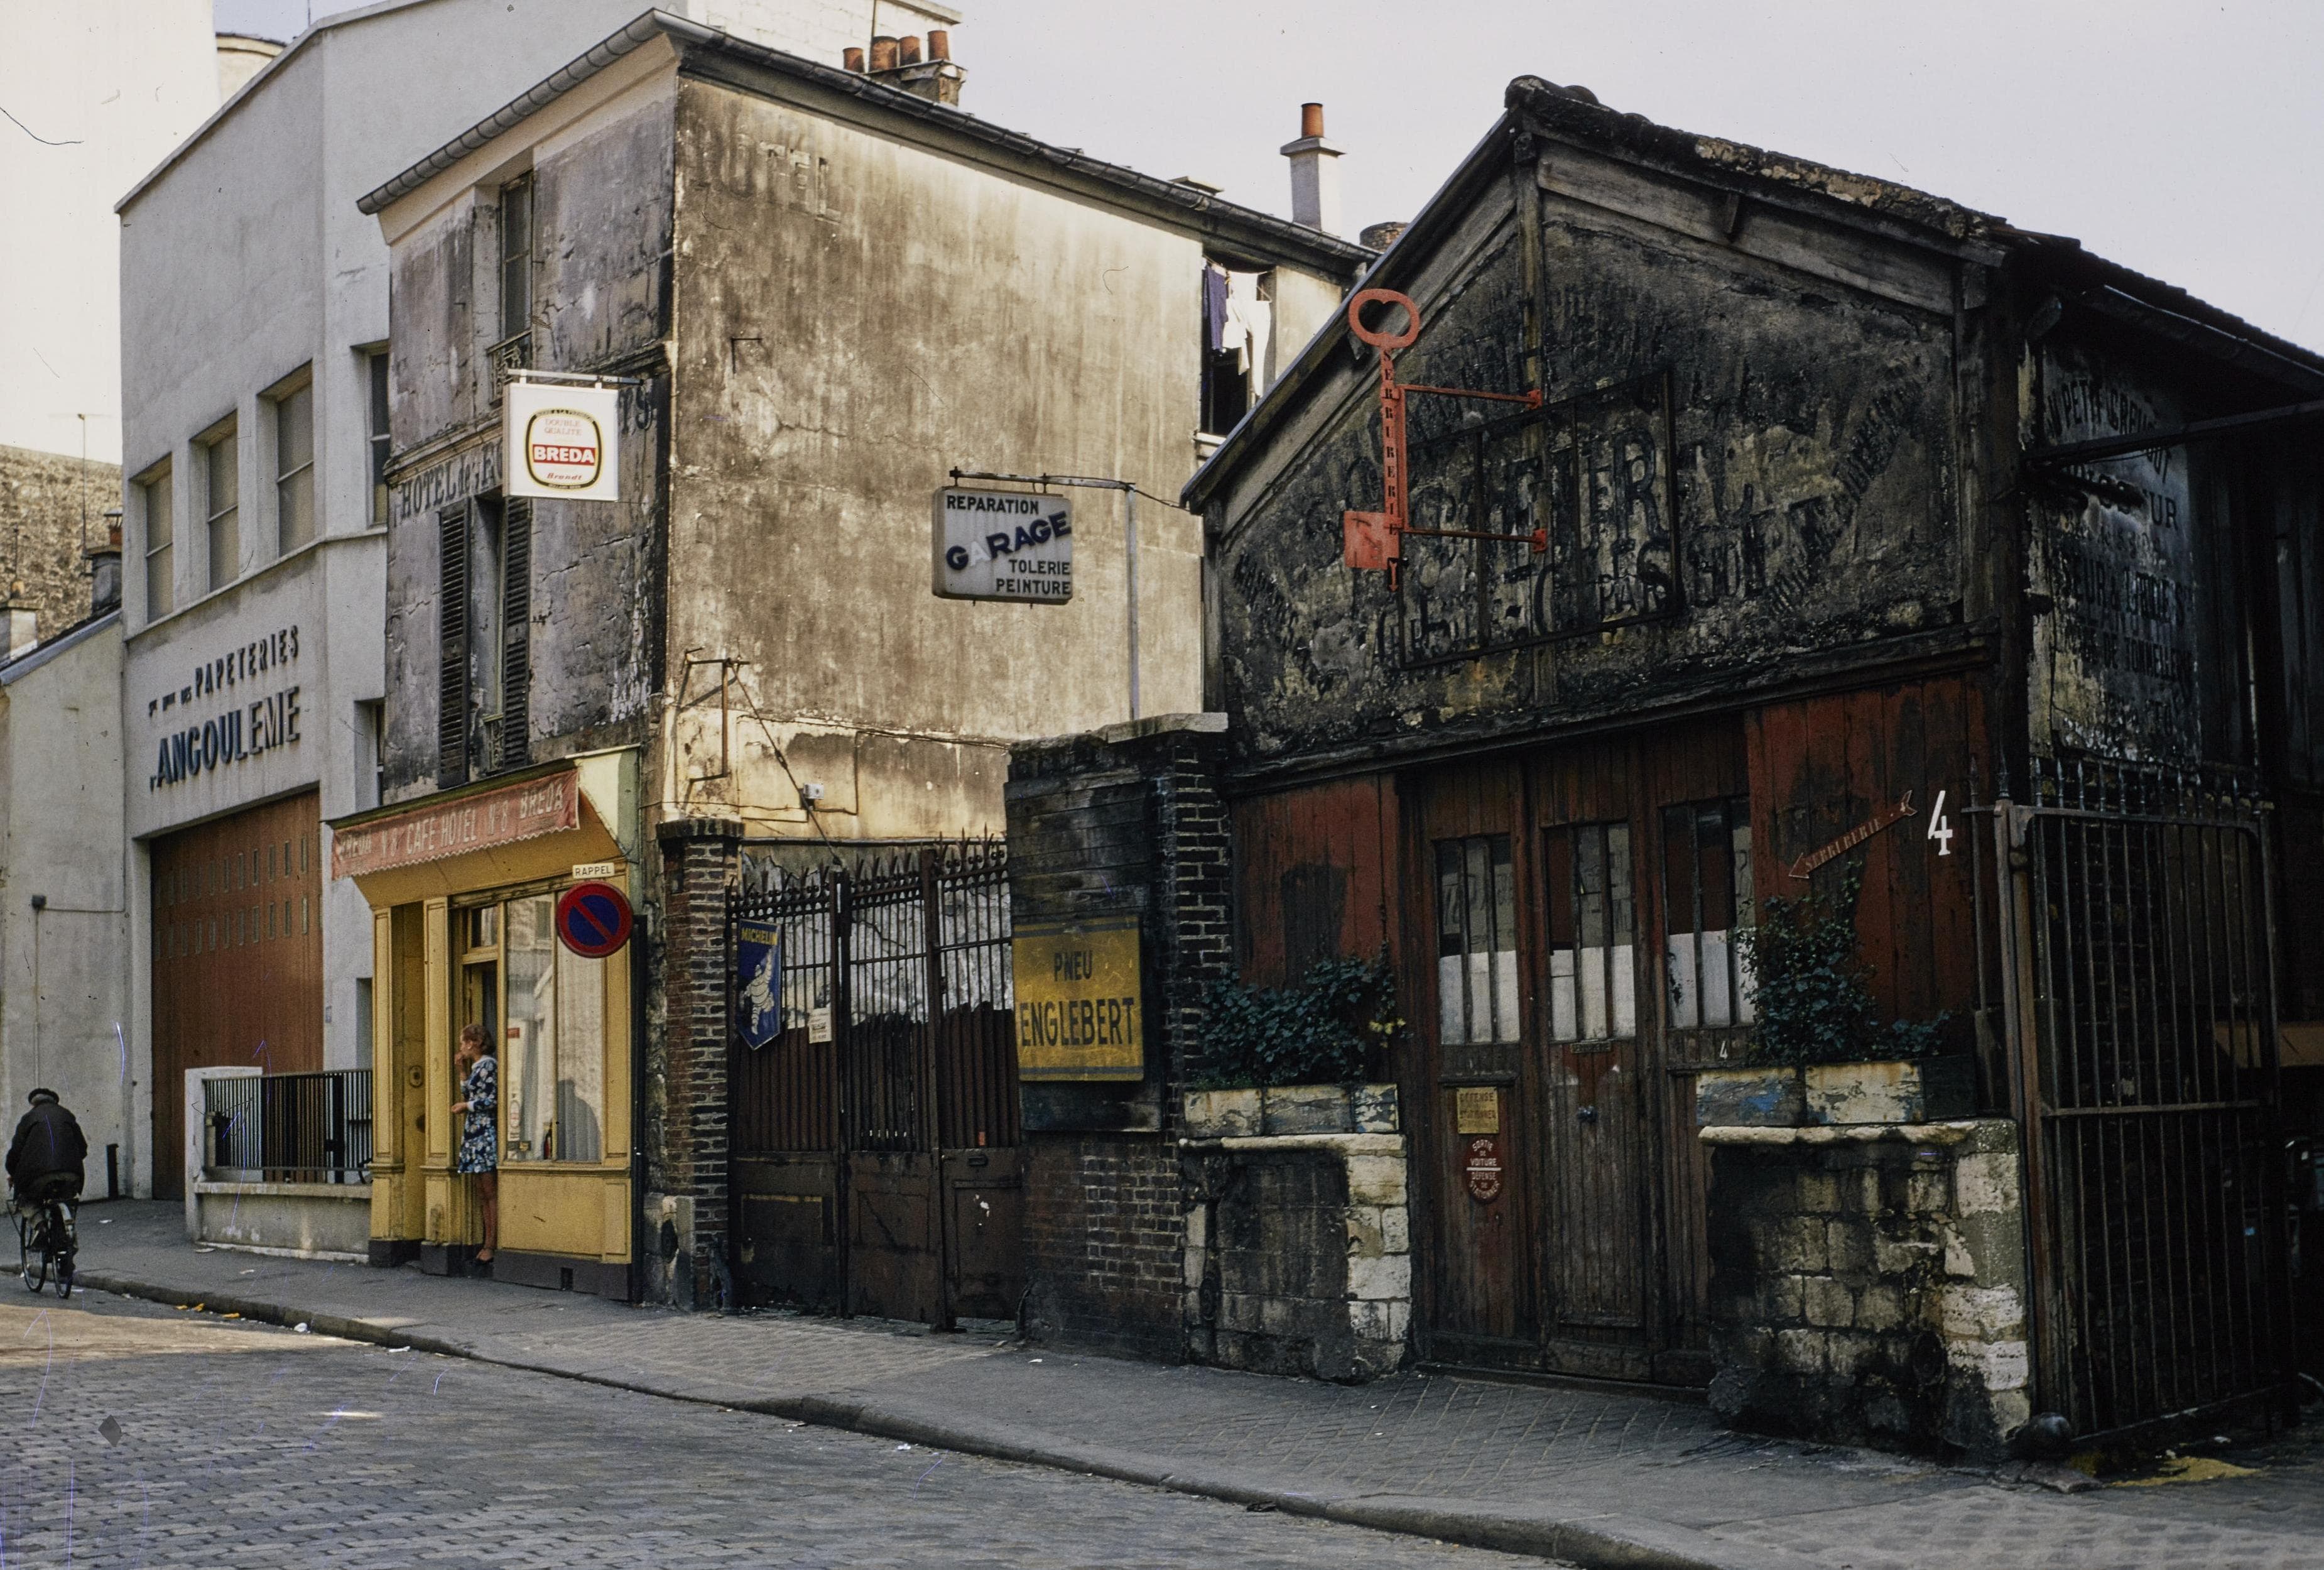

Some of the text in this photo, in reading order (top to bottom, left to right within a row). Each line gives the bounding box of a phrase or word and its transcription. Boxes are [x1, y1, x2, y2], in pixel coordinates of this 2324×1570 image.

[534, 446, 595, 464] BREDA
[401, 460, 457, 520] HOTEL
[947, 495, 1039, 515] REPARATION
[946, 510, 1072, 570] GARAGE
[1009, 559, 1070, 575] TOLERIE
[996, 579, 1071, 595] PEINTURE
[195, 625, 299, 698] PAPETERIES
[441, 808, 477, 846] HOTEL
[520, 781, 564, 819] BREDA
[1928, 790, 1953, 856] 4
[574, 865, 612, 876] RAPPEL
[741, 927, 778, 946] MICHELIN
[1054, 950, 1093, 981] PNEU
[1020, 997, 1135, 1047] ENGLEBERT
[1470, 1158, 1497, 1167] VOITURE
